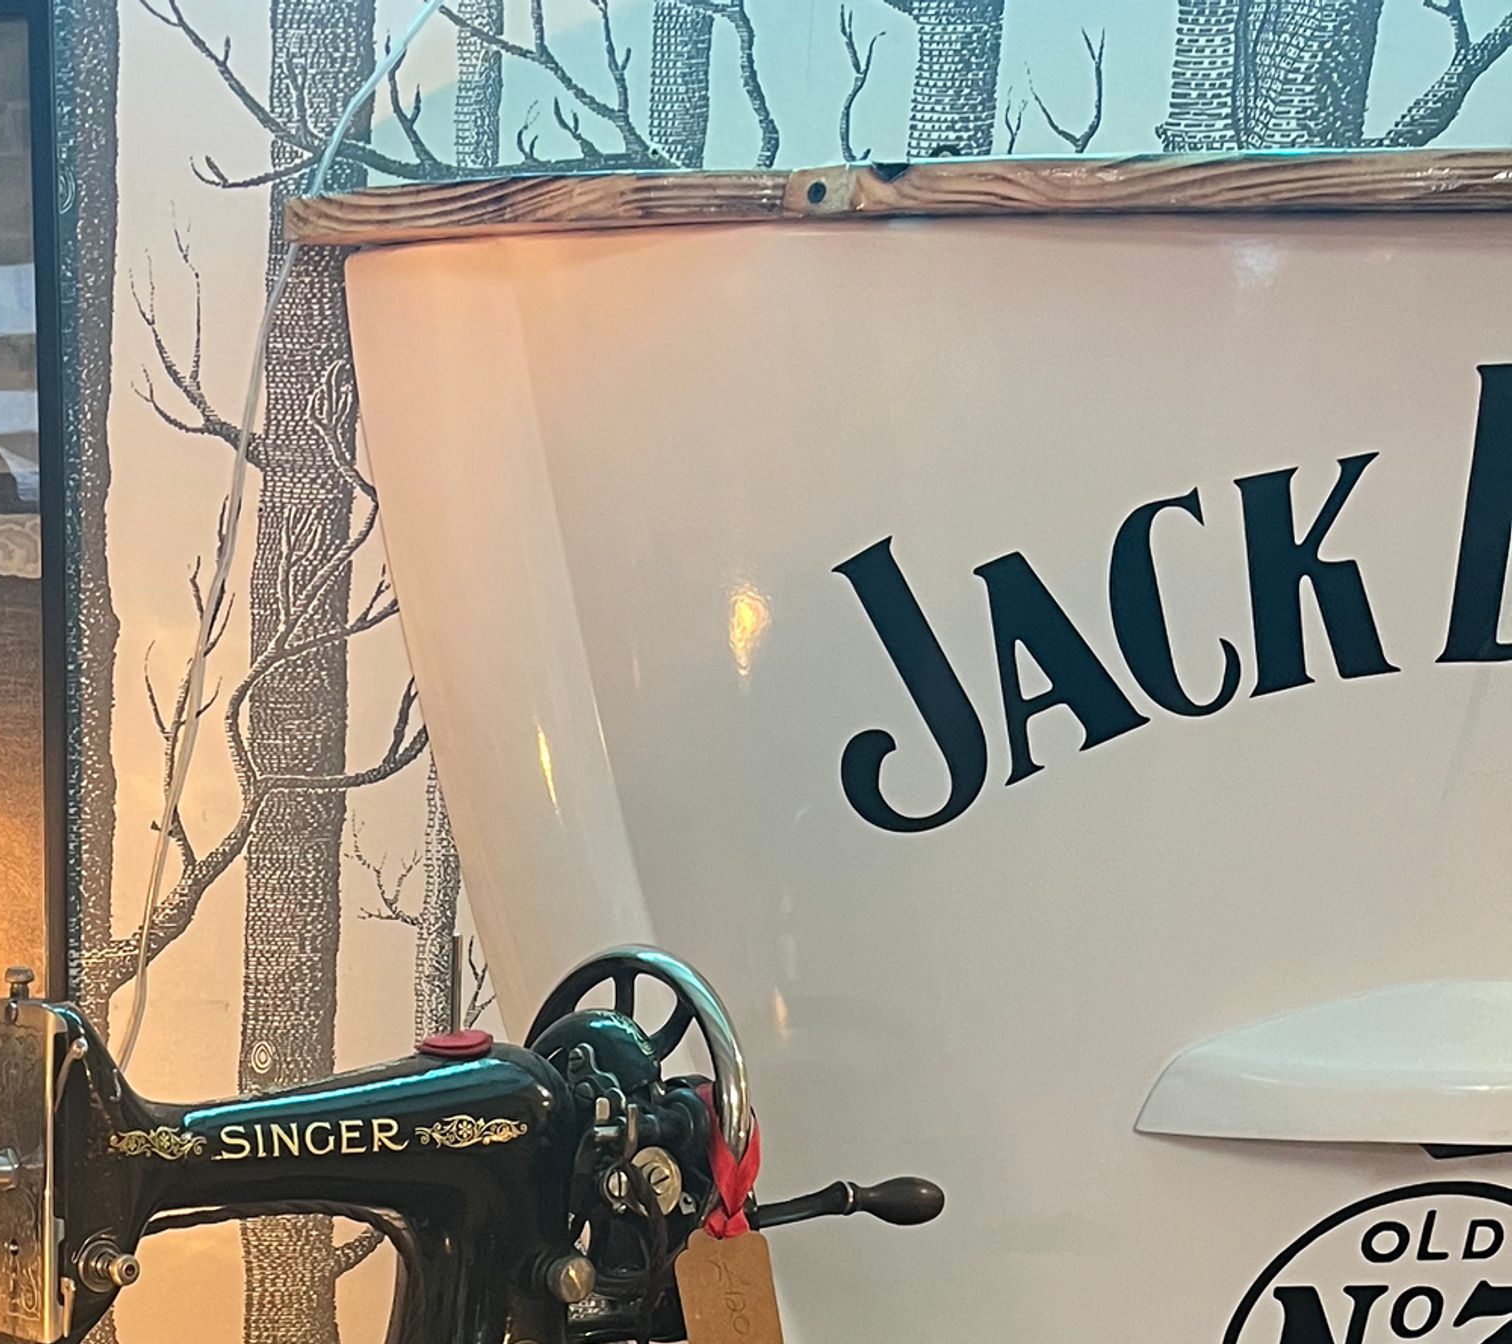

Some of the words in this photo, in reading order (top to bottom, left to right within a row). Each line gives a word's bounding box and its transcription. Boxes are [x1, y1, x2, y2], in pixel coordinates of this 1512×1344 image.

[831, 452, 1402, 833] JACK
[211, 1118, 409, 1161] SINGER
[1361, 1209, 1504, 1263] OLD
